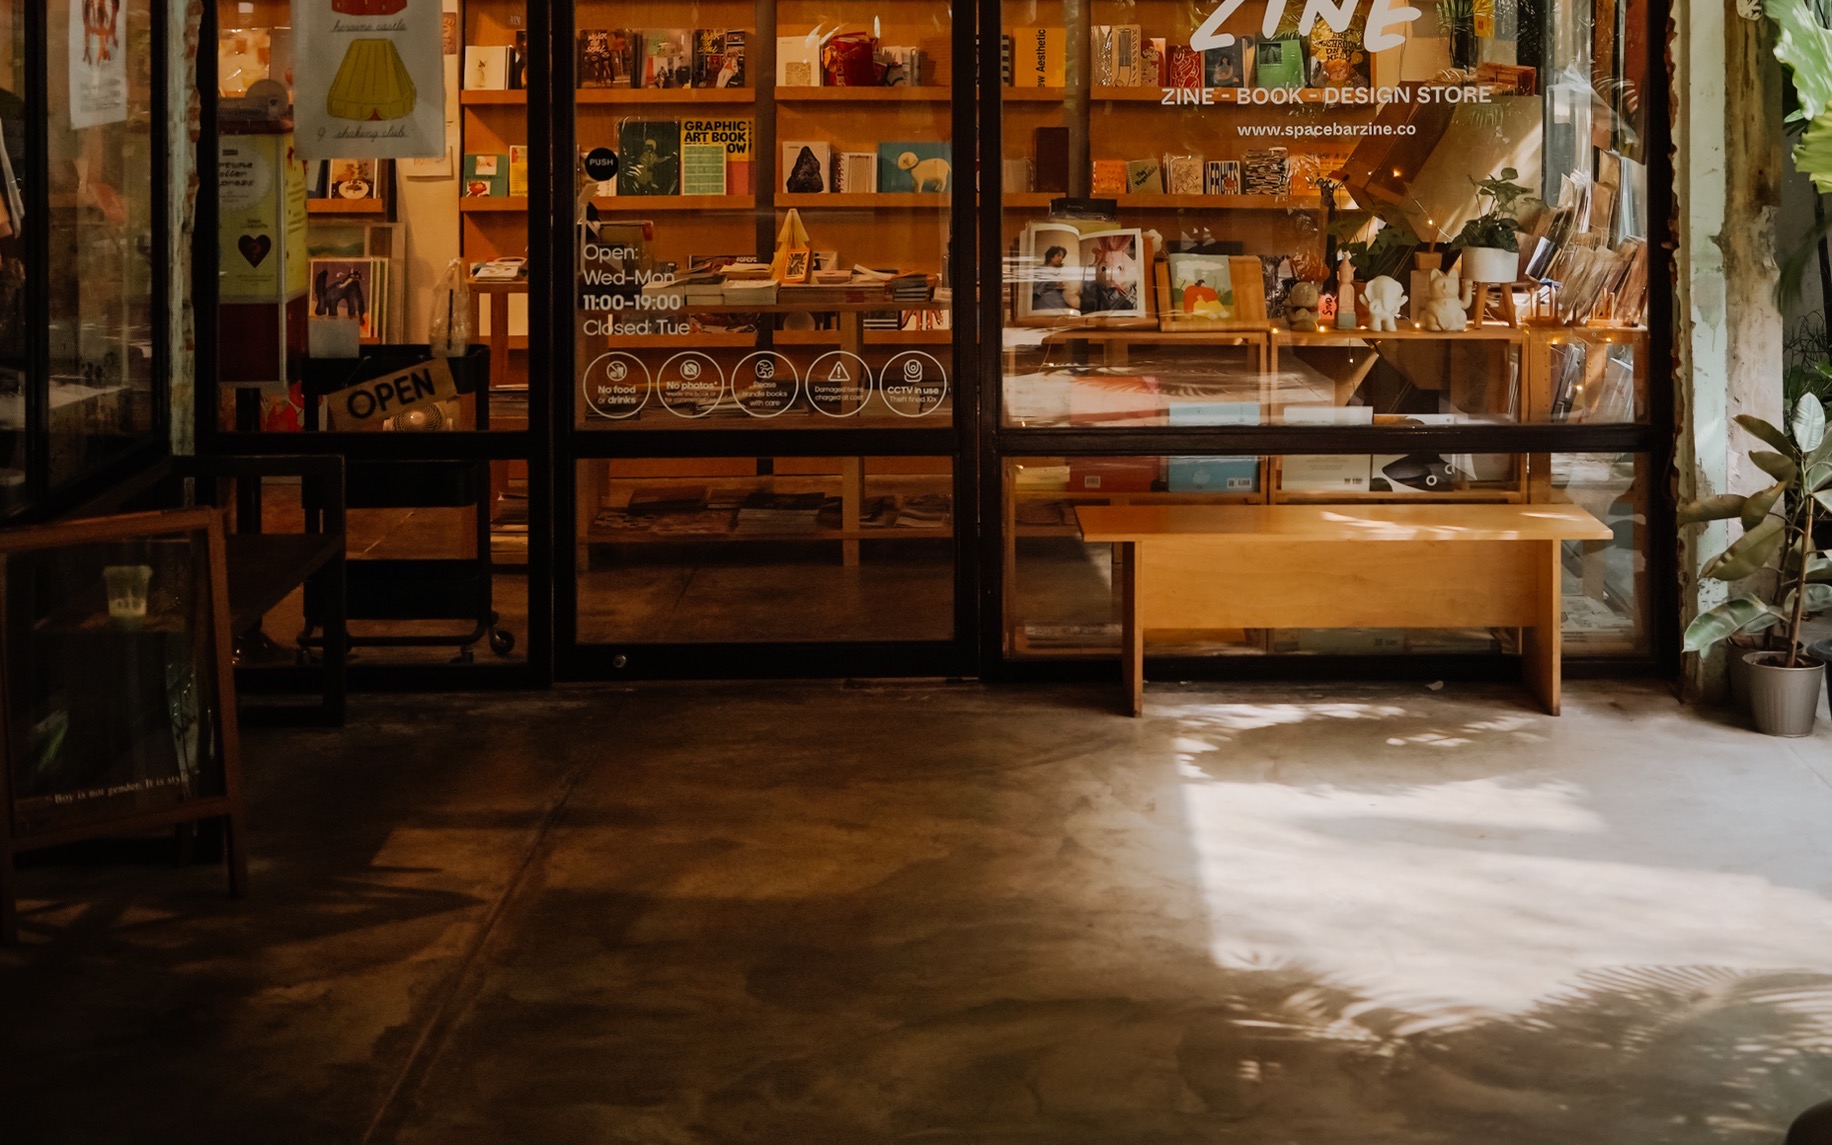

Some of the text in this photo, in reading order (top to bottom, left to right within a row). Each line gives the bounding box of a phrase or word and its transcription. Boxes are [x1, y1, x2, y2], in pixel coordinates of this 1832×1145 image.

[1036, 29, 1046, 73] Aesthetic
[1161, 87, 1215, 105] ZINE
[1236, 87, 1304, 105] BOOK
[1324, 86, 1410, 104] DESIGN
[1416, 85, 1492, 104] STORE
[684, 121, 747, 131] GRAPHIC
[1236, 121, 1416, 137] www.spacebarzine.co
[684, 132, 747, 143] ART BOOK
[583, 244, 639, 264] Open:
[583, 269, 675, 285] Wed-Mon
[583, 294, 681, 310] 11:00-19:00
[583, 319, 690, 336] Closed: Tue
[598, 385, 636, 394] No food
[666, 381, 680, 389] No
[887, 386, 913, 394] CCTV
[914, 386, 921, 394] in
[347, 368, 435, 419] OPEN
[608, 396, 637, 404] drinks
